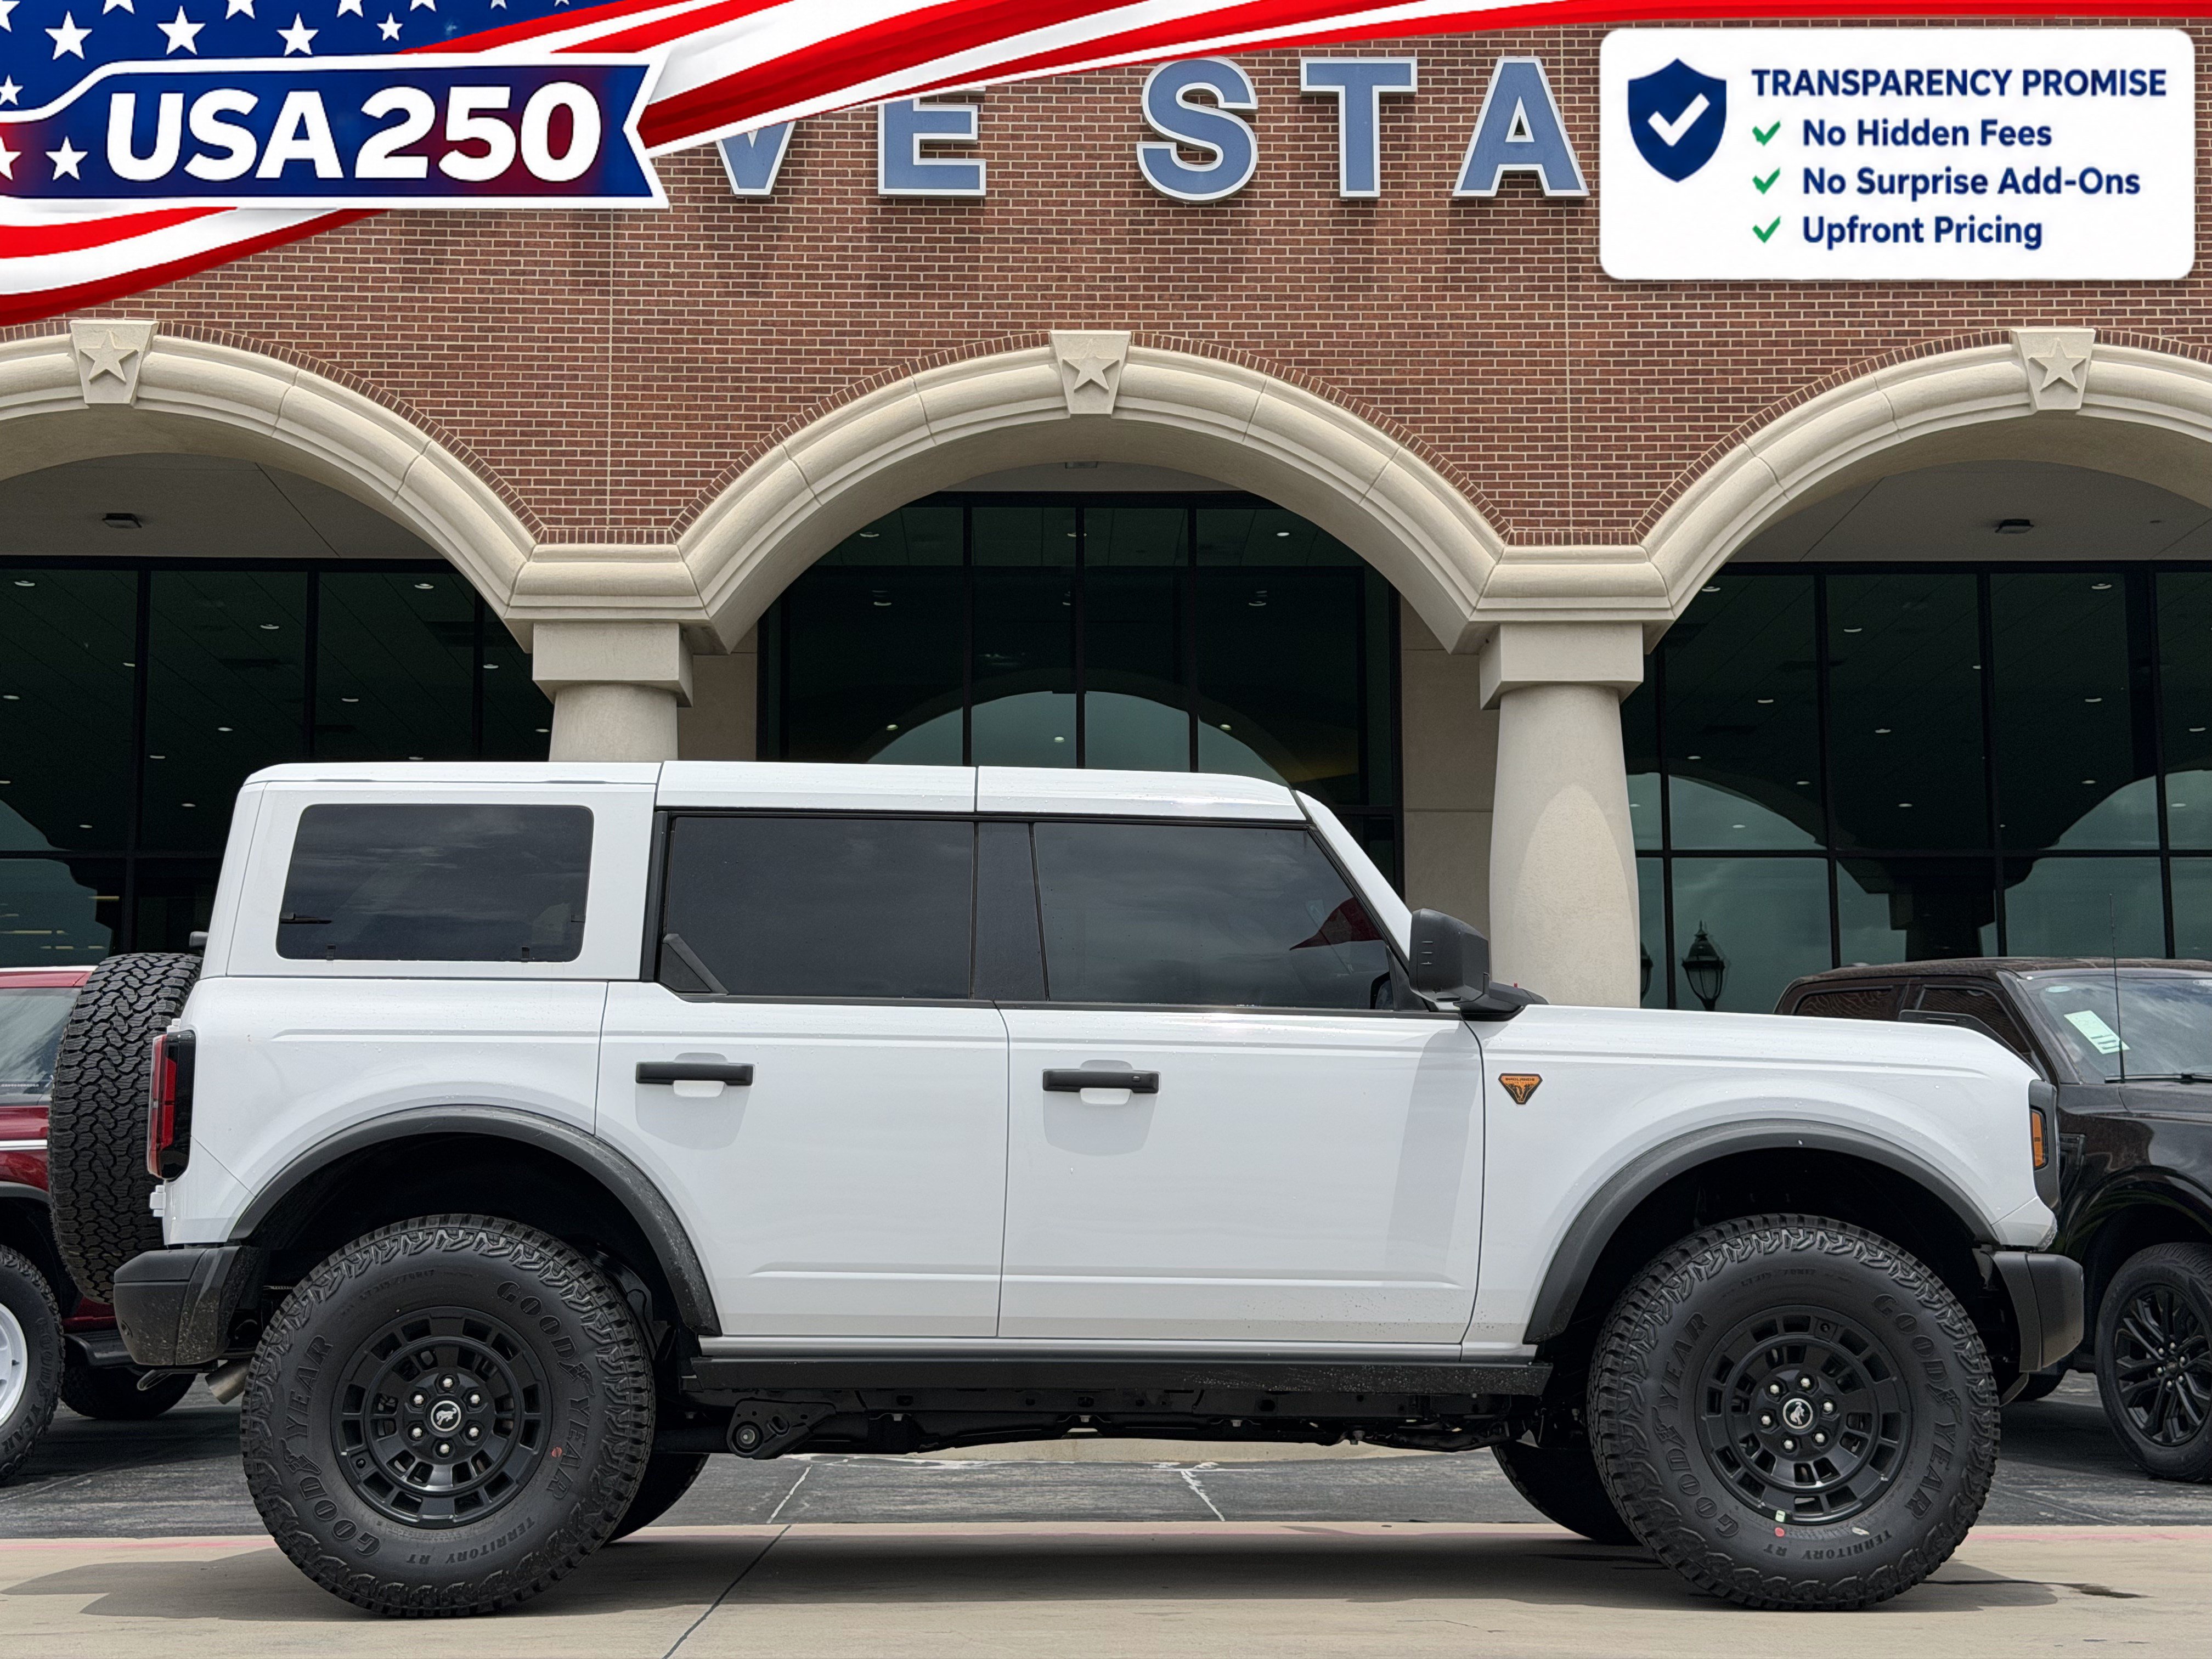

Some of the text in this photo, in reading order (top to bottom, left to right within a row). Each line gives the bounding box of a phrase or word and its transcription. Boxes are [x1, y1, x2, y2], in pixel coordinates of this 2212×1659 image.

[407, 1516, 536, 1565] TERRITORY RT
[1763, 1529, 1893, 1560] TERRITORY RT
